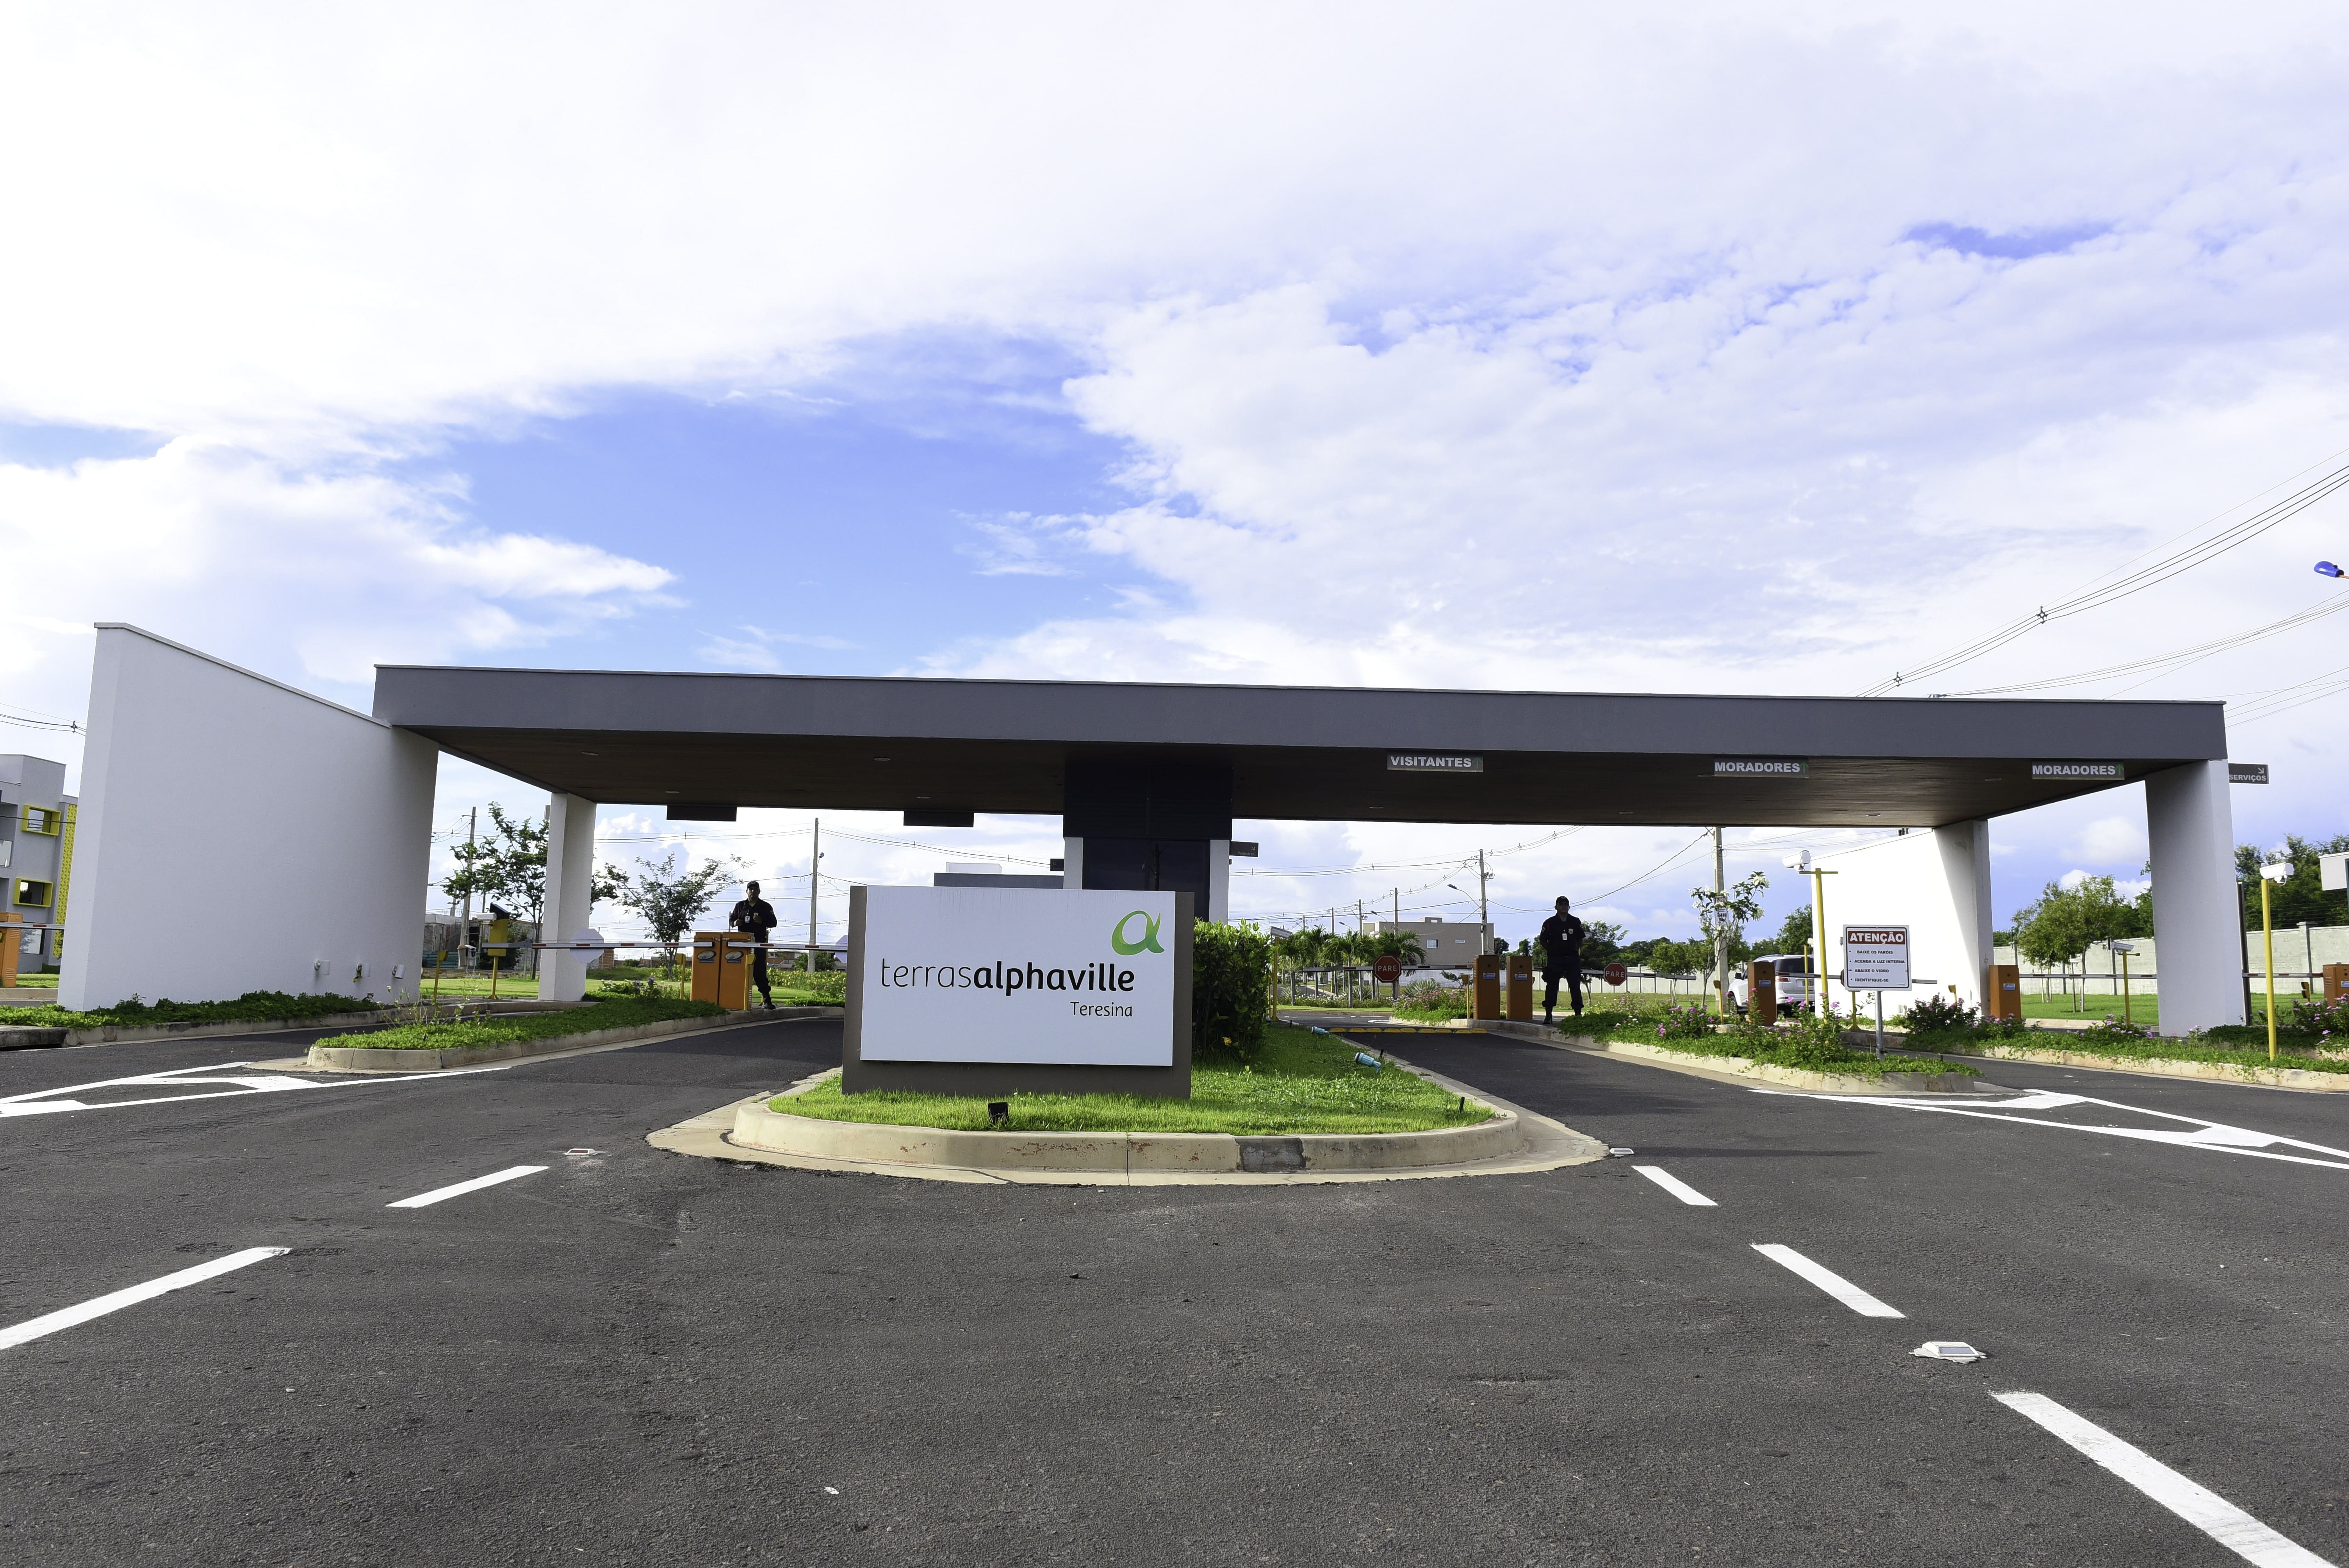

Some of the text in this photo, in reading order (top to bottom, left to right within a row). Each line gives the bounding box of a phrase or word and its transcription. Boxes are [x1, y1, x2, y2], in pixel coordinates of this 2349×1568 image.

[1390, 756, 1472, 768] VISITANTES
[1715, 762, 1800, 772] MORADORES
[2032, 765, 2116, 775] MORADORES
[1850, 932, 1903, 944] ATENÇÃO
[881, 958, 1135, 996] terrasalphaville
[1070, 1001, 1133, 1017] Teresina
